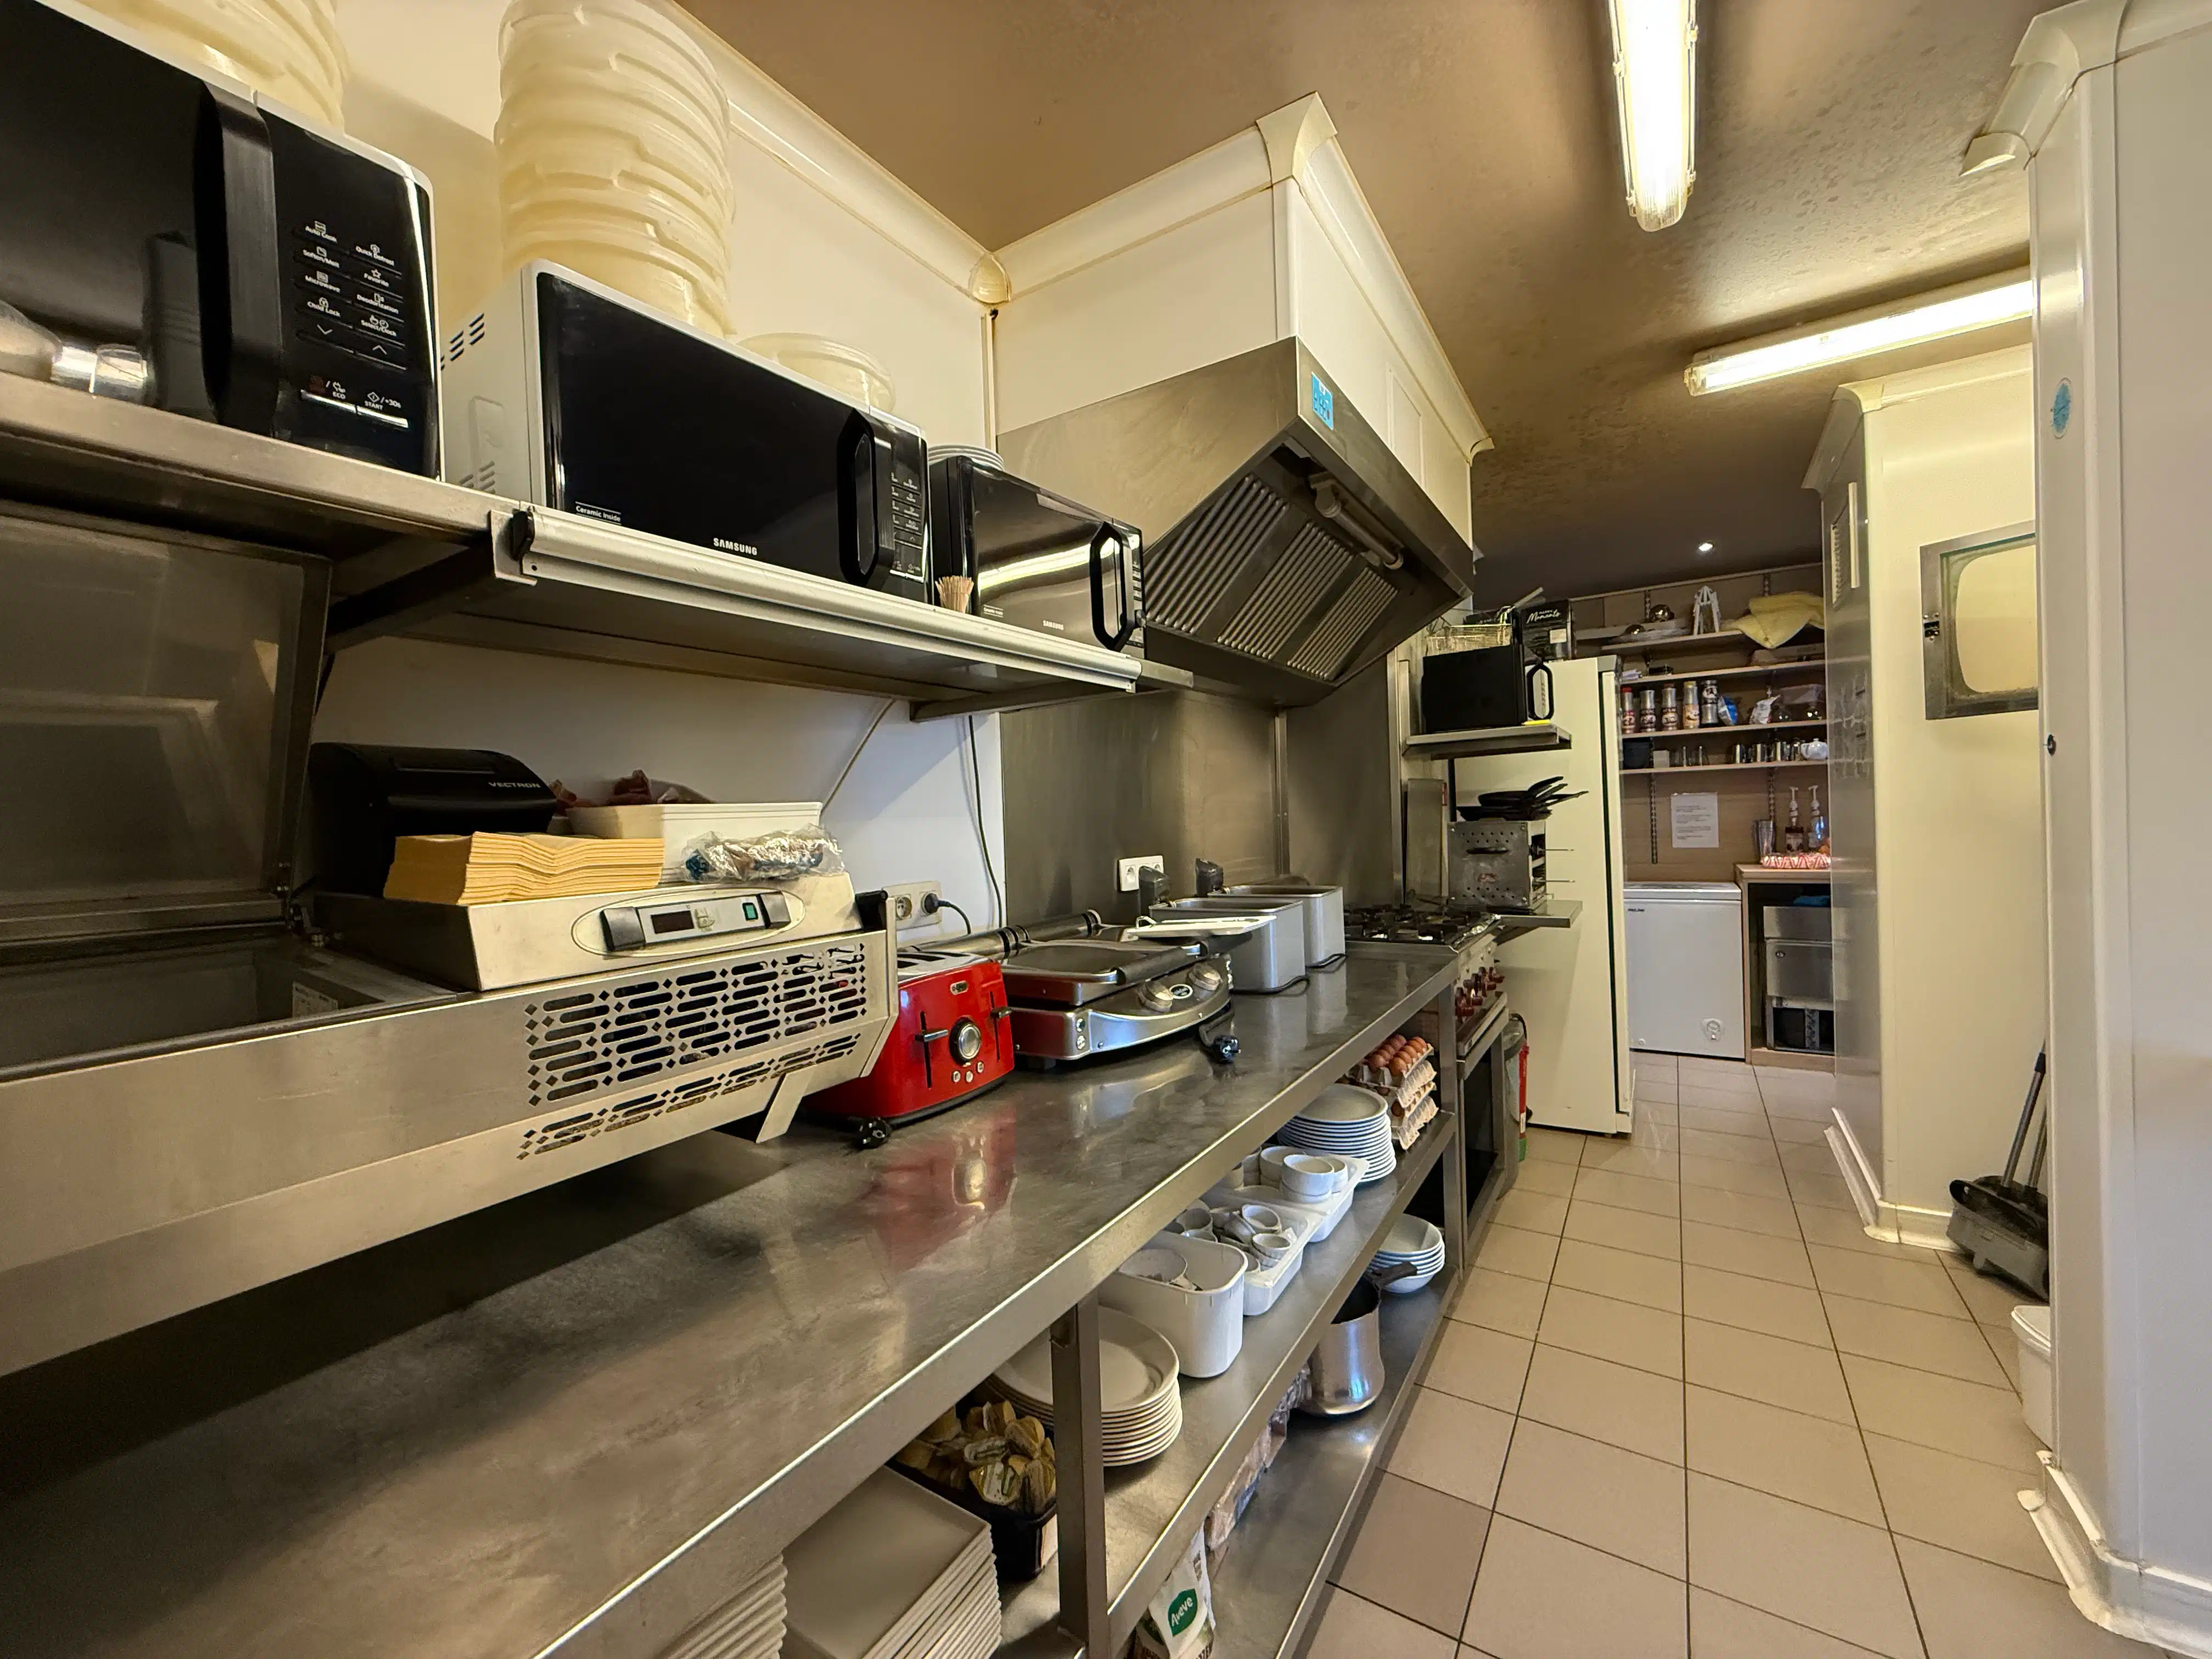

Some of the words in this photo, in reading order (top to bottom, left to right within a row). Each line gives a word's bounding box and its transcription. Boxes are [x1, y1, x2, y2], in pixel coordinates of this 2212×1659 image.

[305, 225, 320, 236] Auto
[321, 232, 338, 244] Cook
[356, 246, 373, 257] Quick
[373, 252, 395, 266] Defrost
[305, 275, 340, 293] Microwave
[364, 273, 390, 287] Favorite
[307, 301, 325, 312] Child
[325, 306, 341, 318] Lock
[357, 294, 399, 314] Deodorization
[332, 391, 346, 399] ECO
[364, 400, 383, 410] START
[575, 505, 602, 517] Ceramic
[602, 512, 621, 522] Inside
[713, 538, 757, 556] SAMSUNG
[1042, 620, 1064, 630] SAMSUNG
[1171, 1596, 1194, 1627] Aveve
